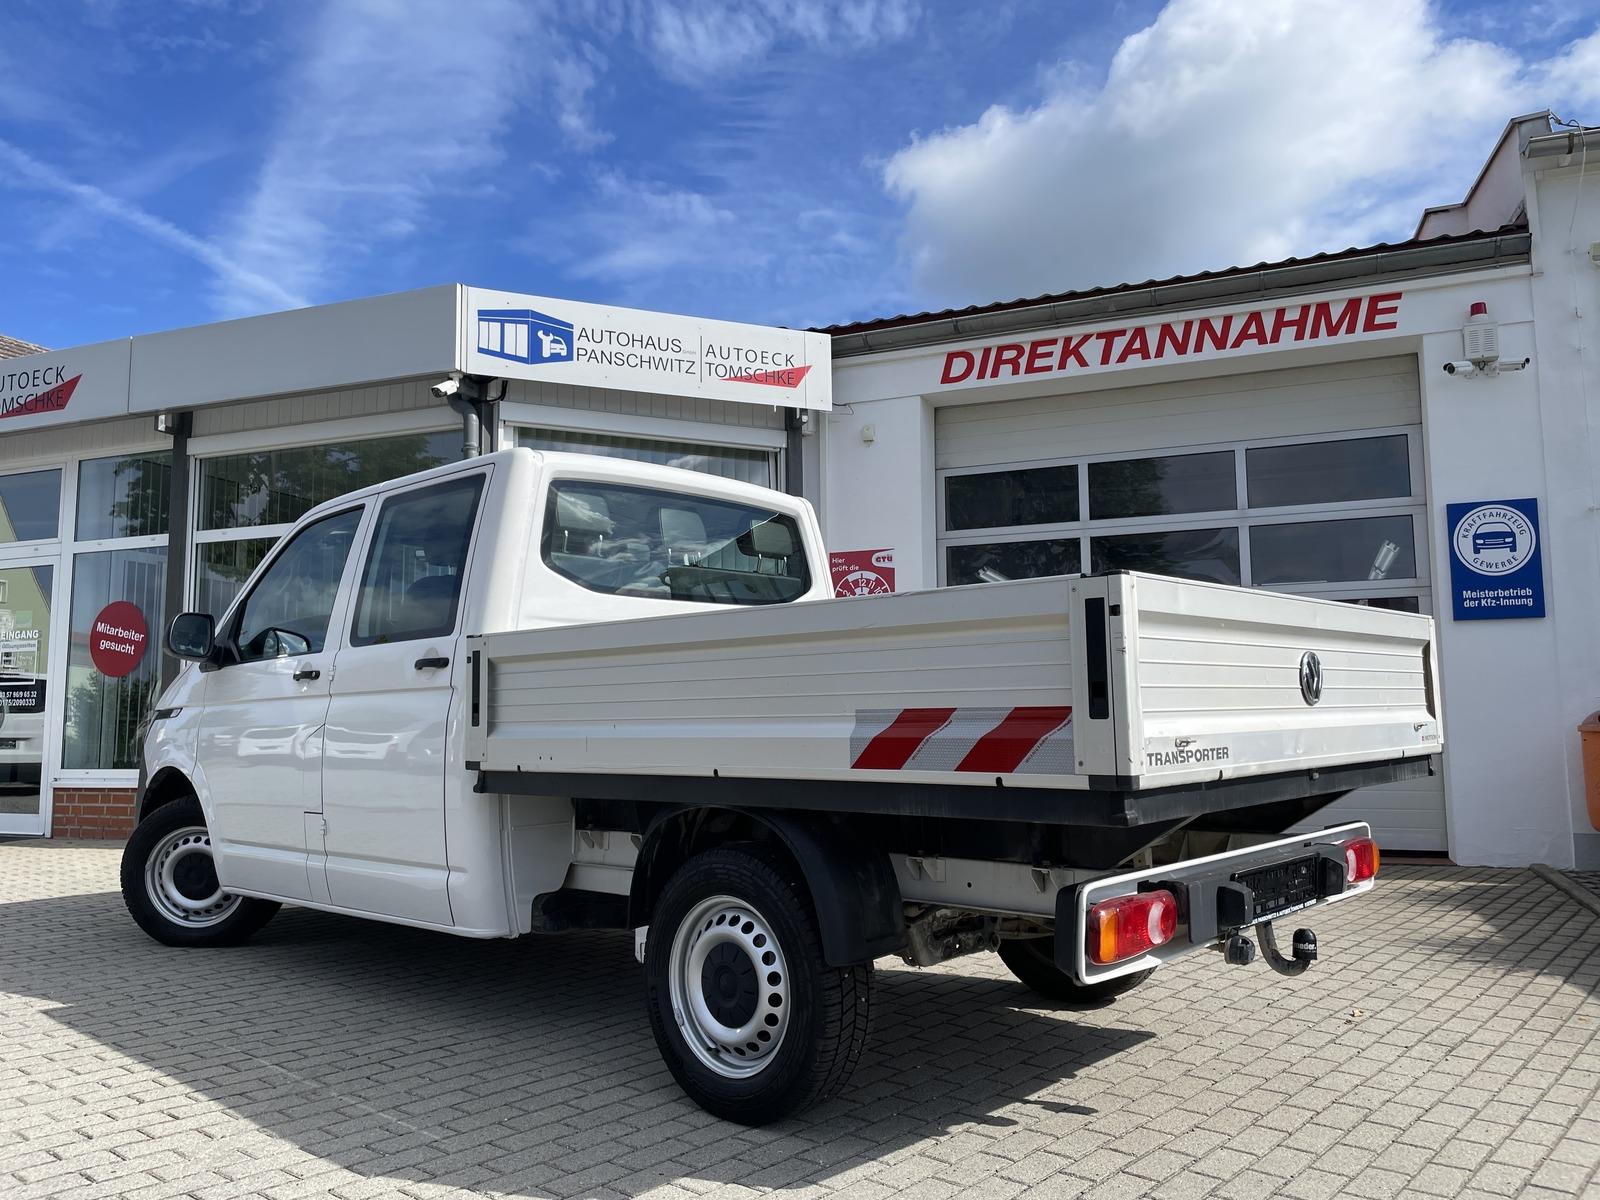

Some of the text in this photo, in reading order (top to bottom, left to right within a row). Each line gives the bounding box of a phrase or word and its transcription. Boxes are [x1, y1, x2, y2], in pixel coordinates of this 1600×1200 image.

[577, 327, 682, 353] AUTOHAUS
[940, 292, 1403, 385] DIREKTANNAHME
[576, 347, 696, 375] PANSCHWITZ
[705, 344, 795, 368] AUTOECK
[704, 362, 795, 386] TOMSCHKE
[0, 389, 64, 415] MSCHKE
[1462, 511, 1527, 539] KRAFTFAHRZEUG
[832, 565, 848, 573] prüft
[1473, 555, 1519, 570] GEWERBE
[858, 578, 867, 587] 12
[1463, 588, 1533, 599] Meisterbetrieb
[1464, 597, 1533, 608] der Kfz-Innung
[1, 629, 39, 640] EINGANG
[96, 621, 144, 642] Mitarbeiter
[99, 639, 135, 655] gesucht
[1147, 746, 1229, 767] TRANSPORTER
